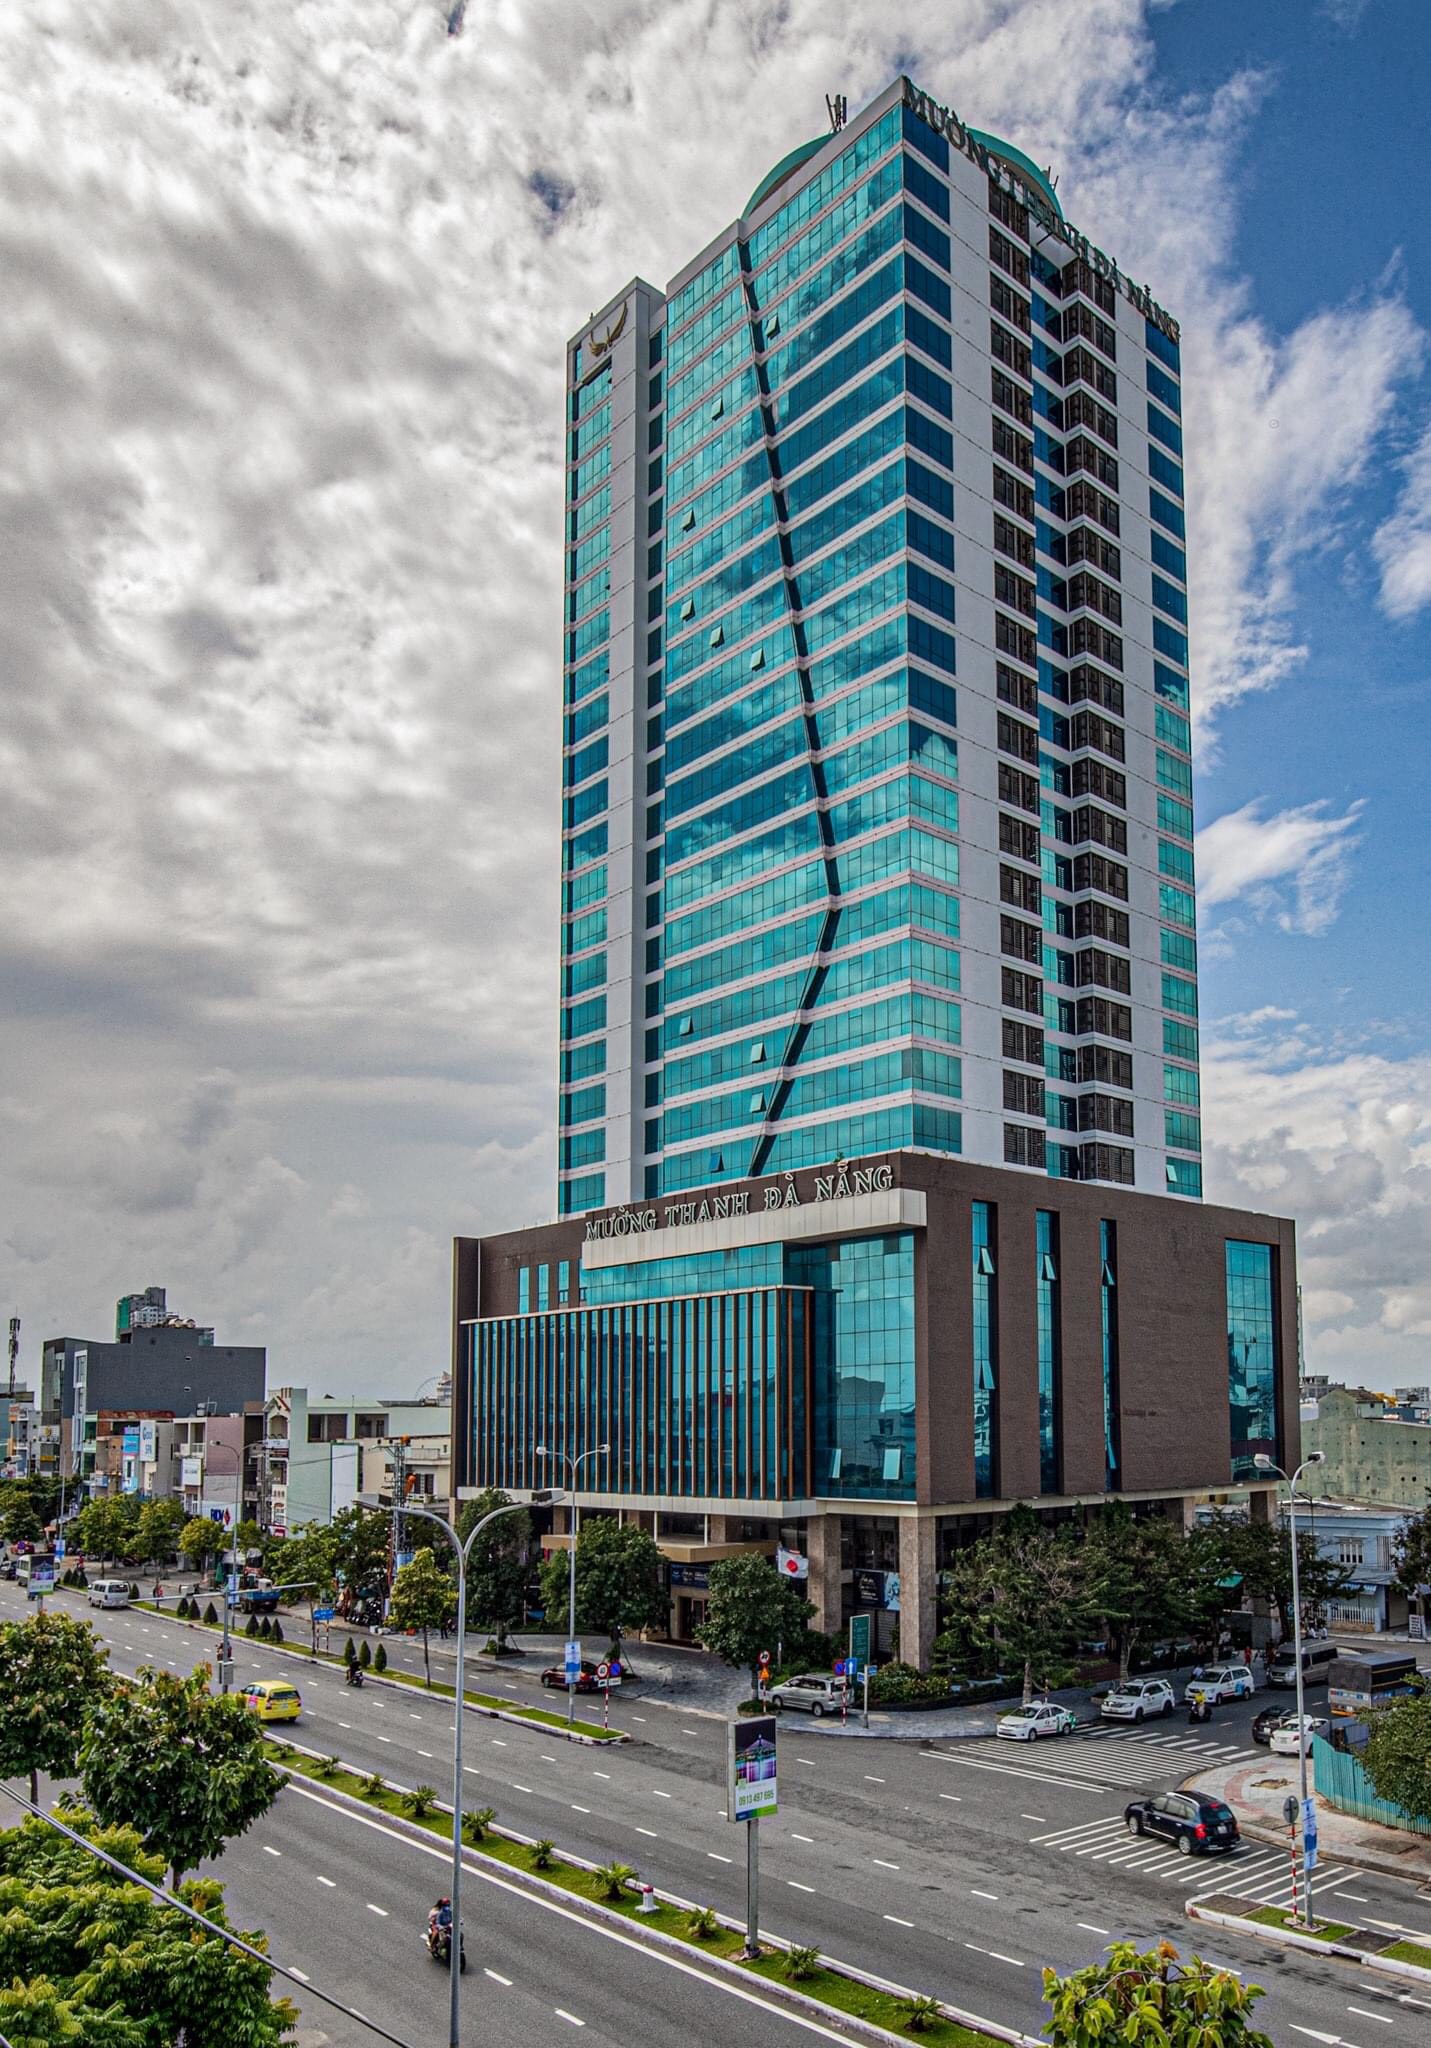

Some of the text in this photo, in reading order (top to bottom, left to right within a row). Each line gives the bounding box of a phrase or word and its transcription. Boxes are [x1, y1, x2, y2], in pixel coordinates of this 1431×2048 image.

[585, 1159, 894, 1242] MƯỜNG THANH ĐÀ NẴNG
